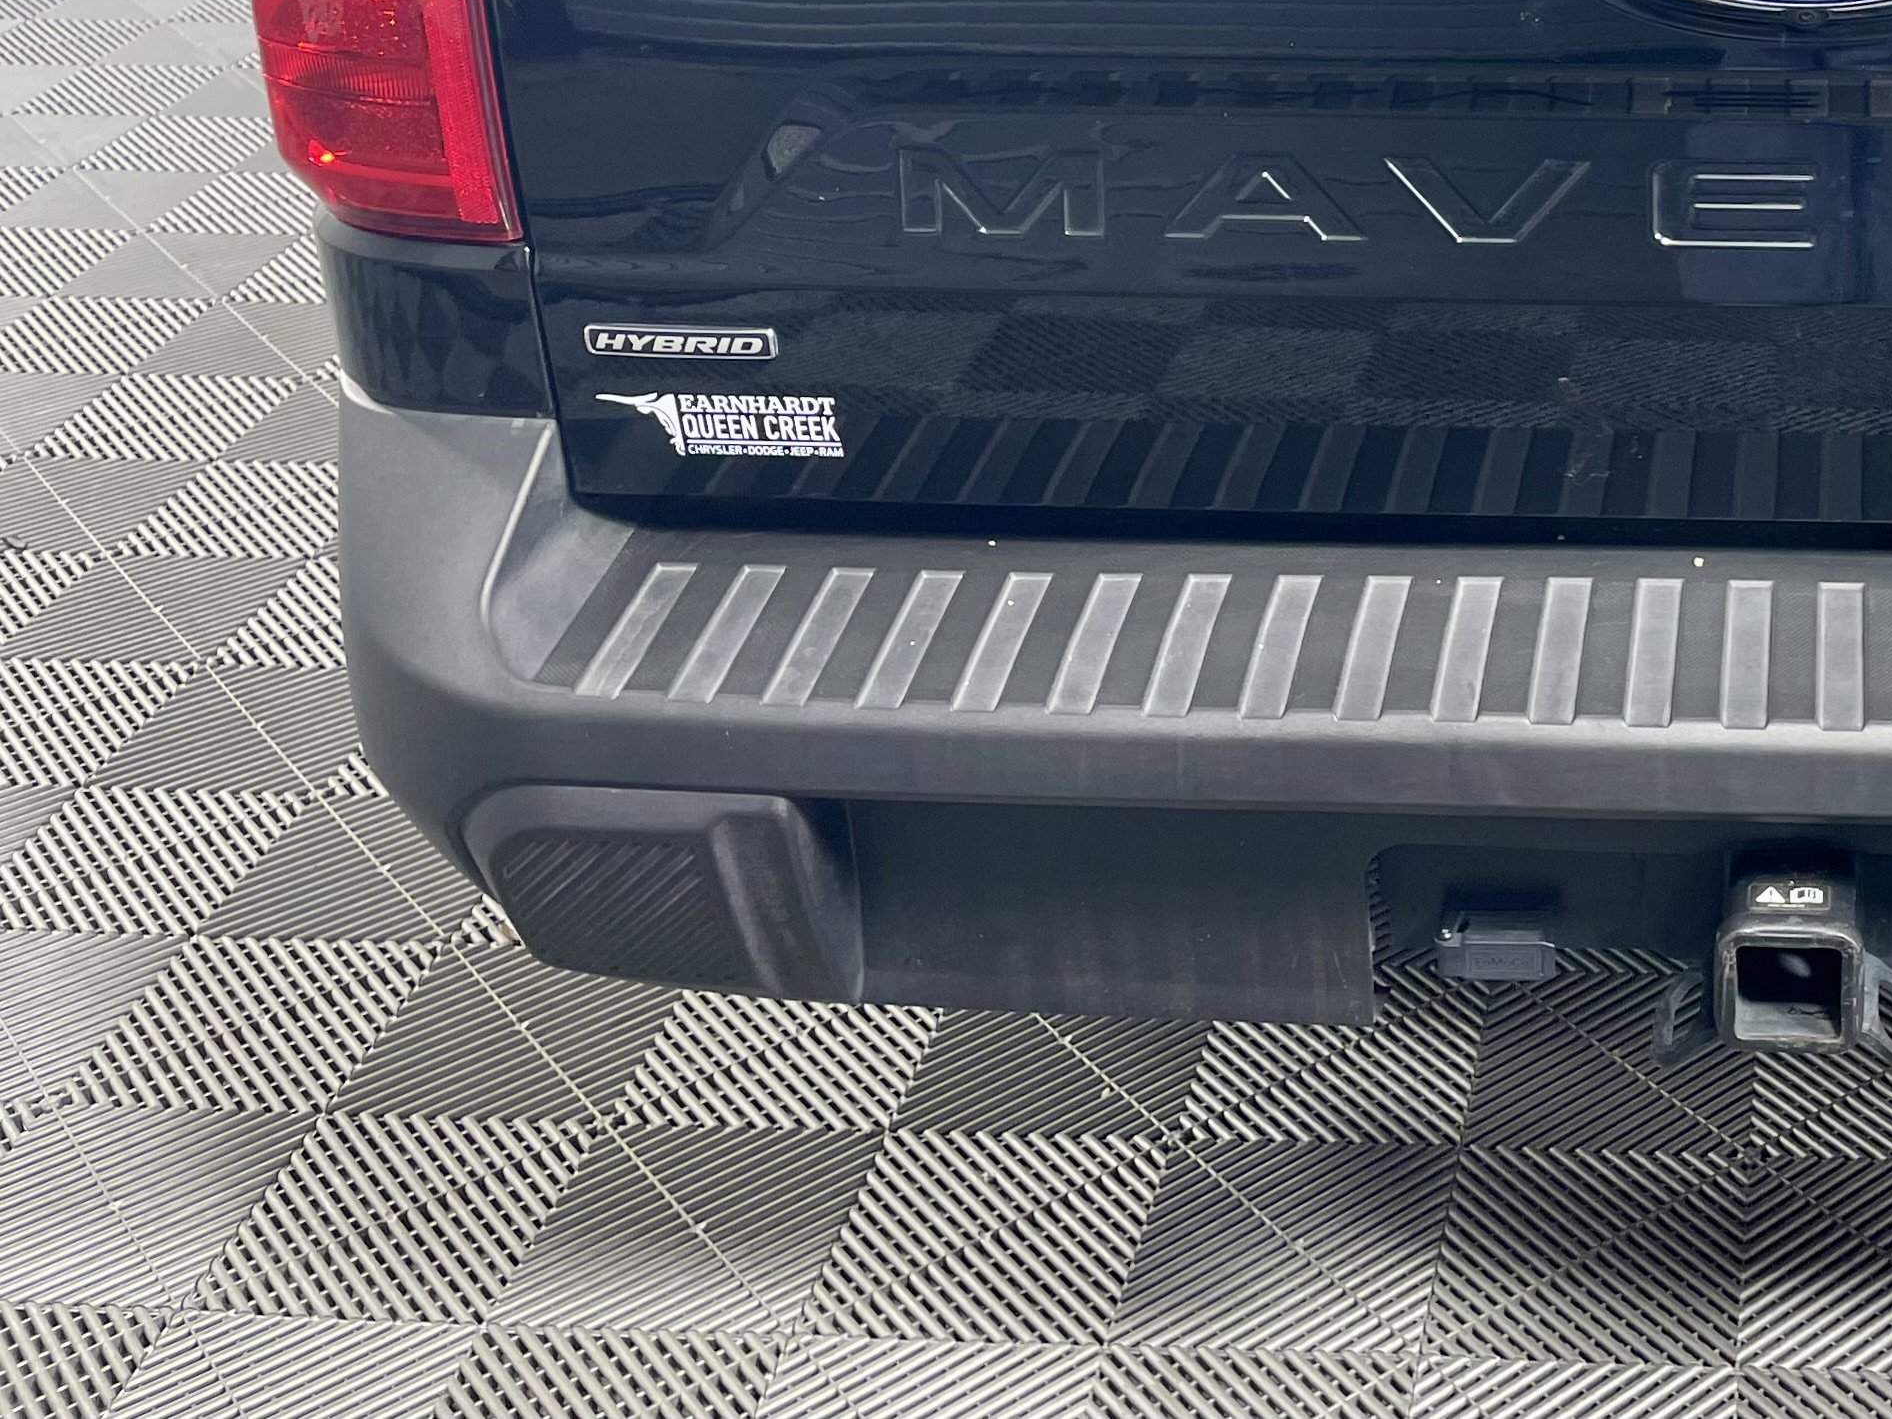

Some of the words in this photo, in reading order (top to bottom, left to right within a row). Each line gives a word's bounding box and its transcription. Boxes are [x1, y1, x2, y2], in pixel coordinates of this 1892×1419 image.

[595, 332, 764, 355] HYBRID
[677, 394, 836, 416] EARNHARDT
[682, 413, 760, 440] QUEEN
[763, 415, 841, 442] CREEK
[687, 444, 744, 456] CHRYSLER
[747, 446, 785, 457] DODGE
